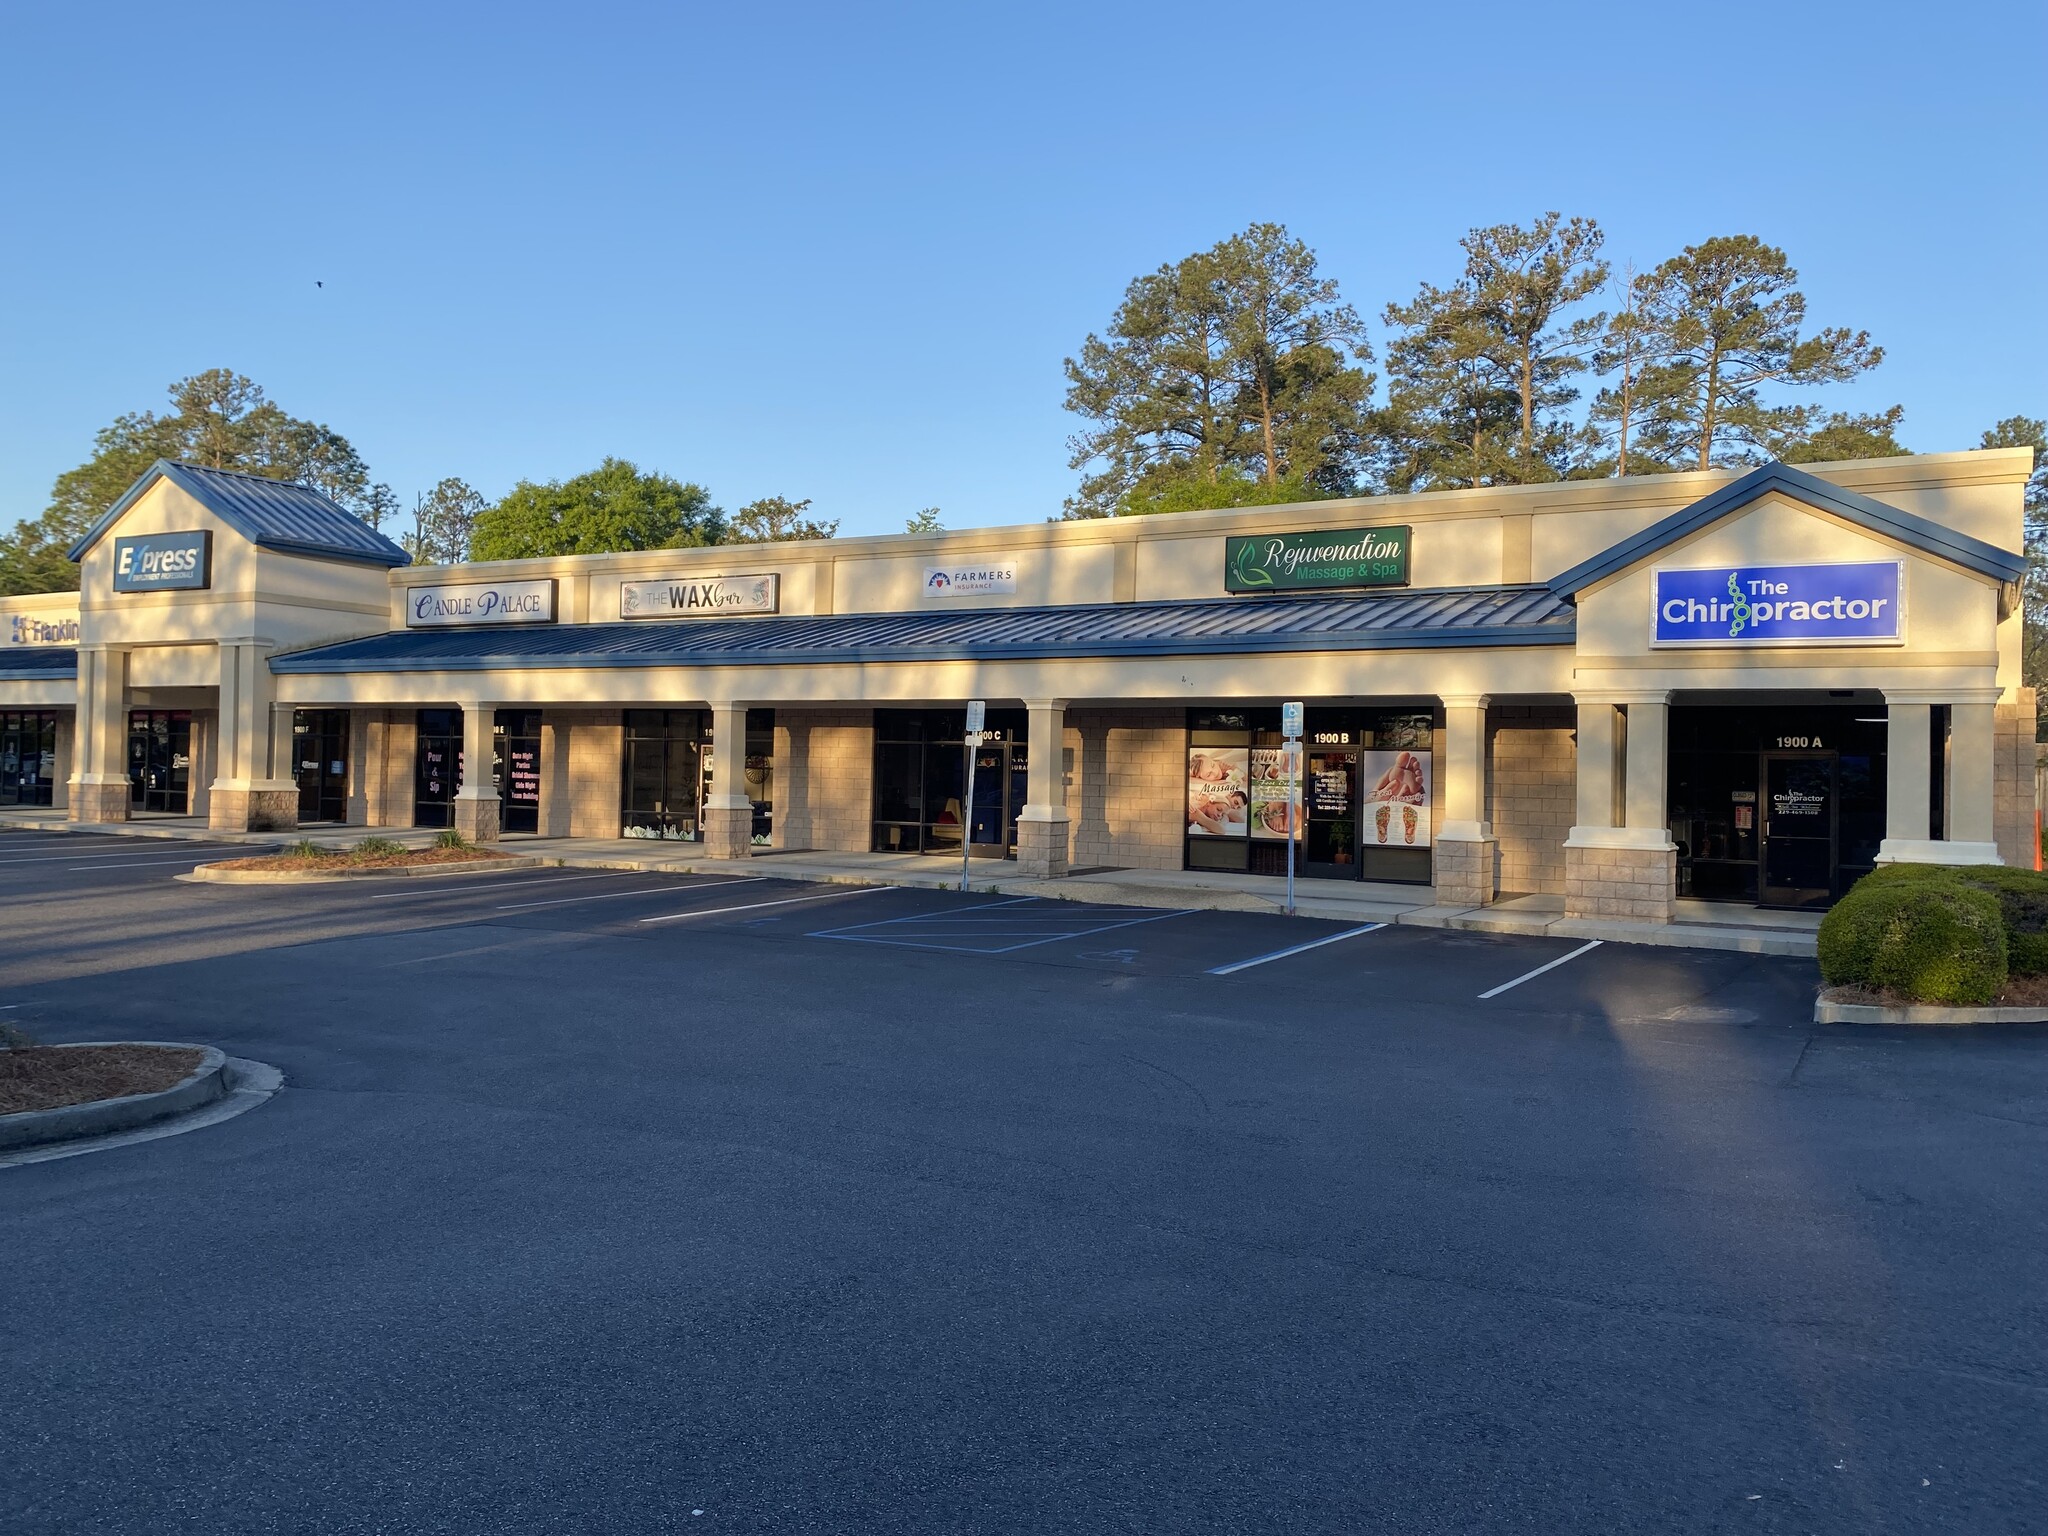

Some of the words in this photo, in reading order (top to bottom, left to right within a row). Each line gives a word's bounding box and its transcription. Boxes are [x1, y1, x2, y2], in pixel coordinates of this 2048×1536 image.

[1263, 533, 1401, 575] Rejuvenation
[954, 570, 1012, 582] FARMERS
[1297, 566, 1354, 581] Massage
[1358, 563, 1368, 577] &
[1372, 563, 1398, 579] Spa
[646, 591, 668, 605] THE
[669, 584, 714, 608] WAX
[714, 582, 745, 608] bar
[1747, 579, 1789, 596] The
[415, 594, 472, 619] CANDLE
[477, 591, 540, 616] PALACE
[1662, 596, 1888, 627] Chiropractor
[994, 730, 1001, 740] C
[1314, 733, 1339, 744] 1900
[1341, 733, 1349, 744] B
[1777, 736, 1808, 747] 1900
[1812, 736, 1823, 748] A
[1199, 783, 1240, 796] Massage
[1774, 794, 1824, 802] Chiropractor
